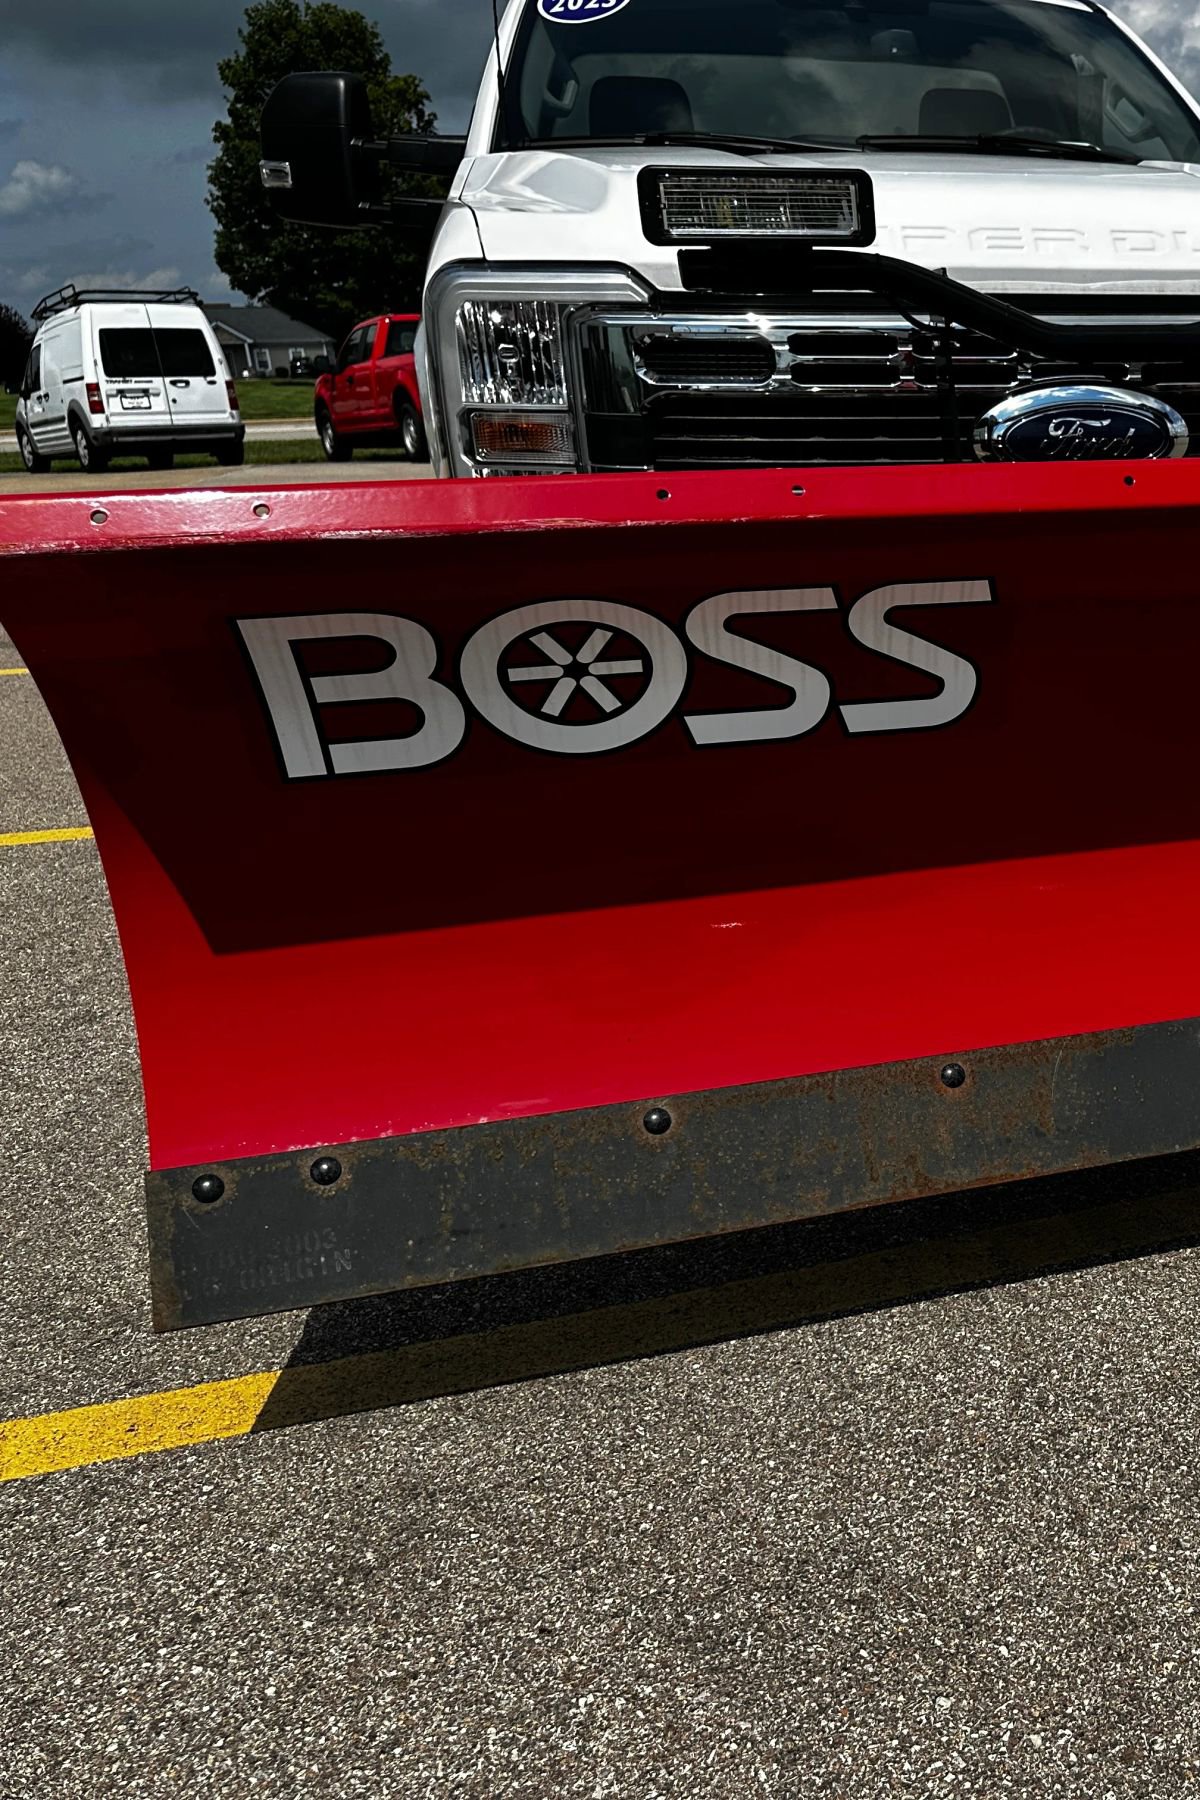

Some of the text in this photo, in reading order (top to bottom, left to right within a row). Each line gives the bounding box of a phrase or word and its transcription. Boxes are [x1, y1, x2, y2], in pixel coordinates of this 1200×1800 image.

[877, 225, 1090, 251] PER
[1041, 416, 1136, 457] Ford
[235, 579, 993, 779] BOSS
